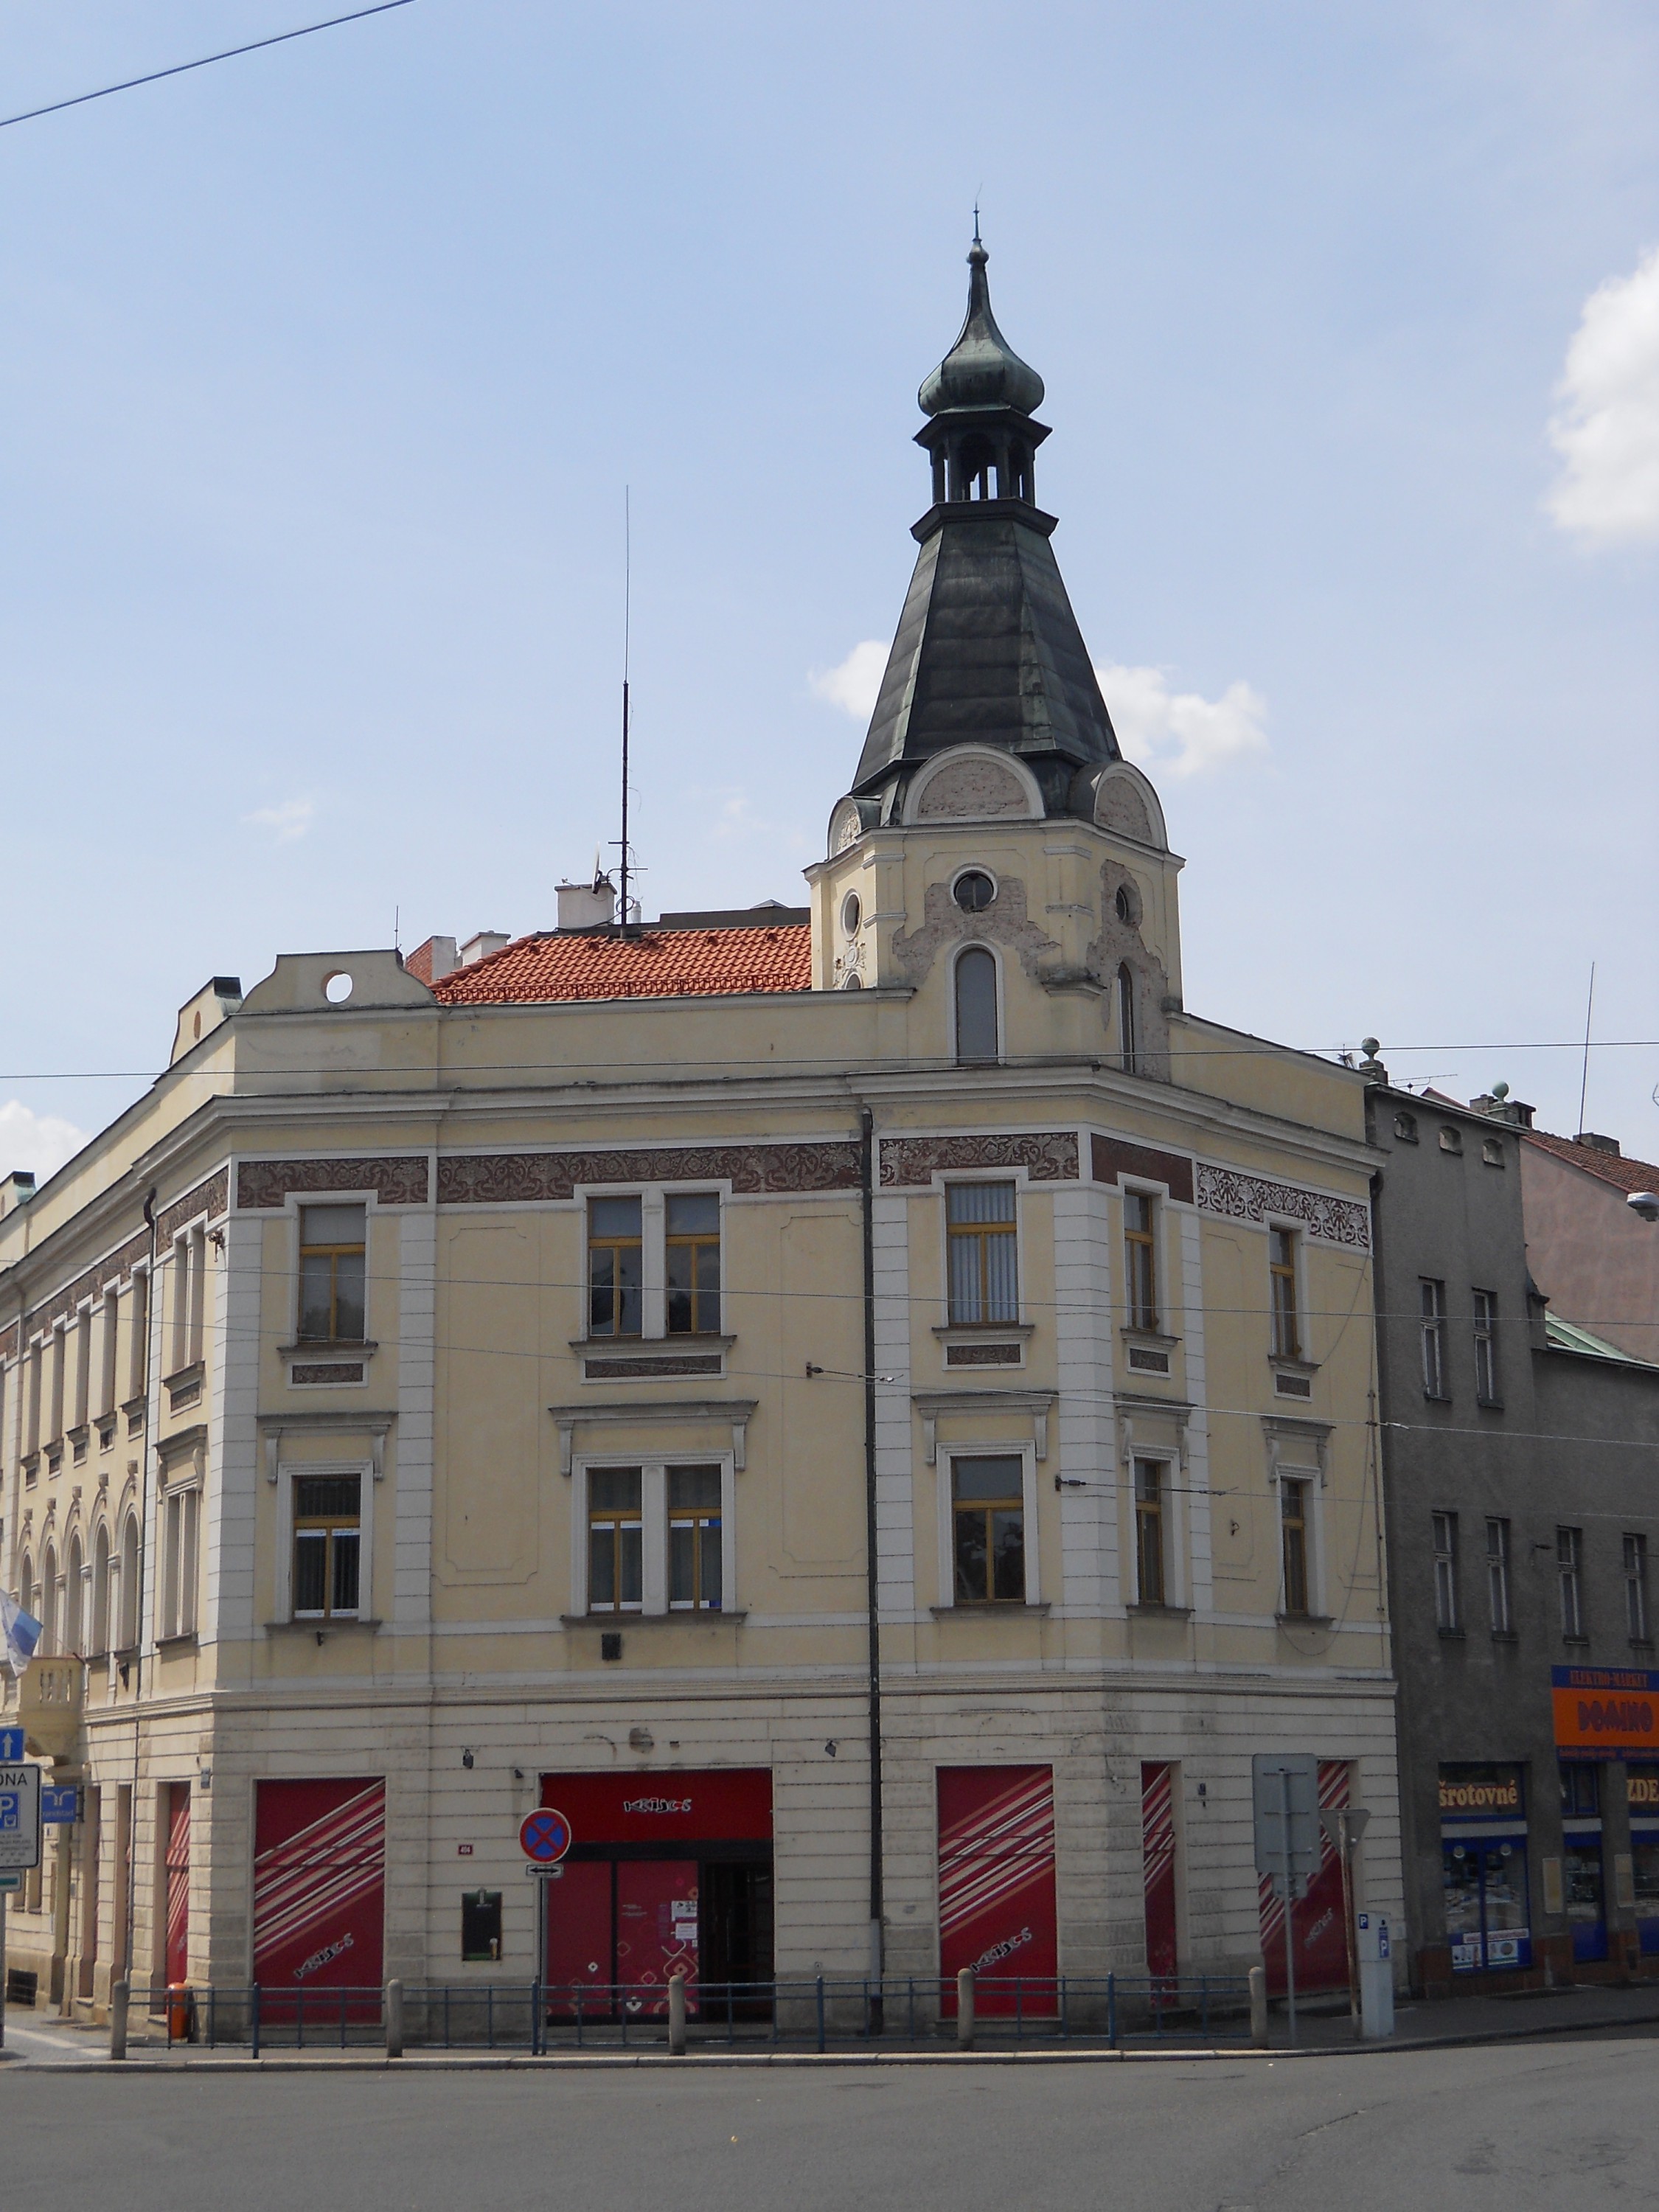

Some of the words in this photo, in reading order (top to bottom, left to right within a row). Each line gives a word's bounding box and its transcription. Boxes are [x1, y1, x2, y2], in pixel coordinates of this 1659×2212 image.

[1578, 1700, 1653, 1733] DOMINO
[1439, 1779, 1517, 1806] šrotovné
[1360, 1917, 1367, 1926] P
